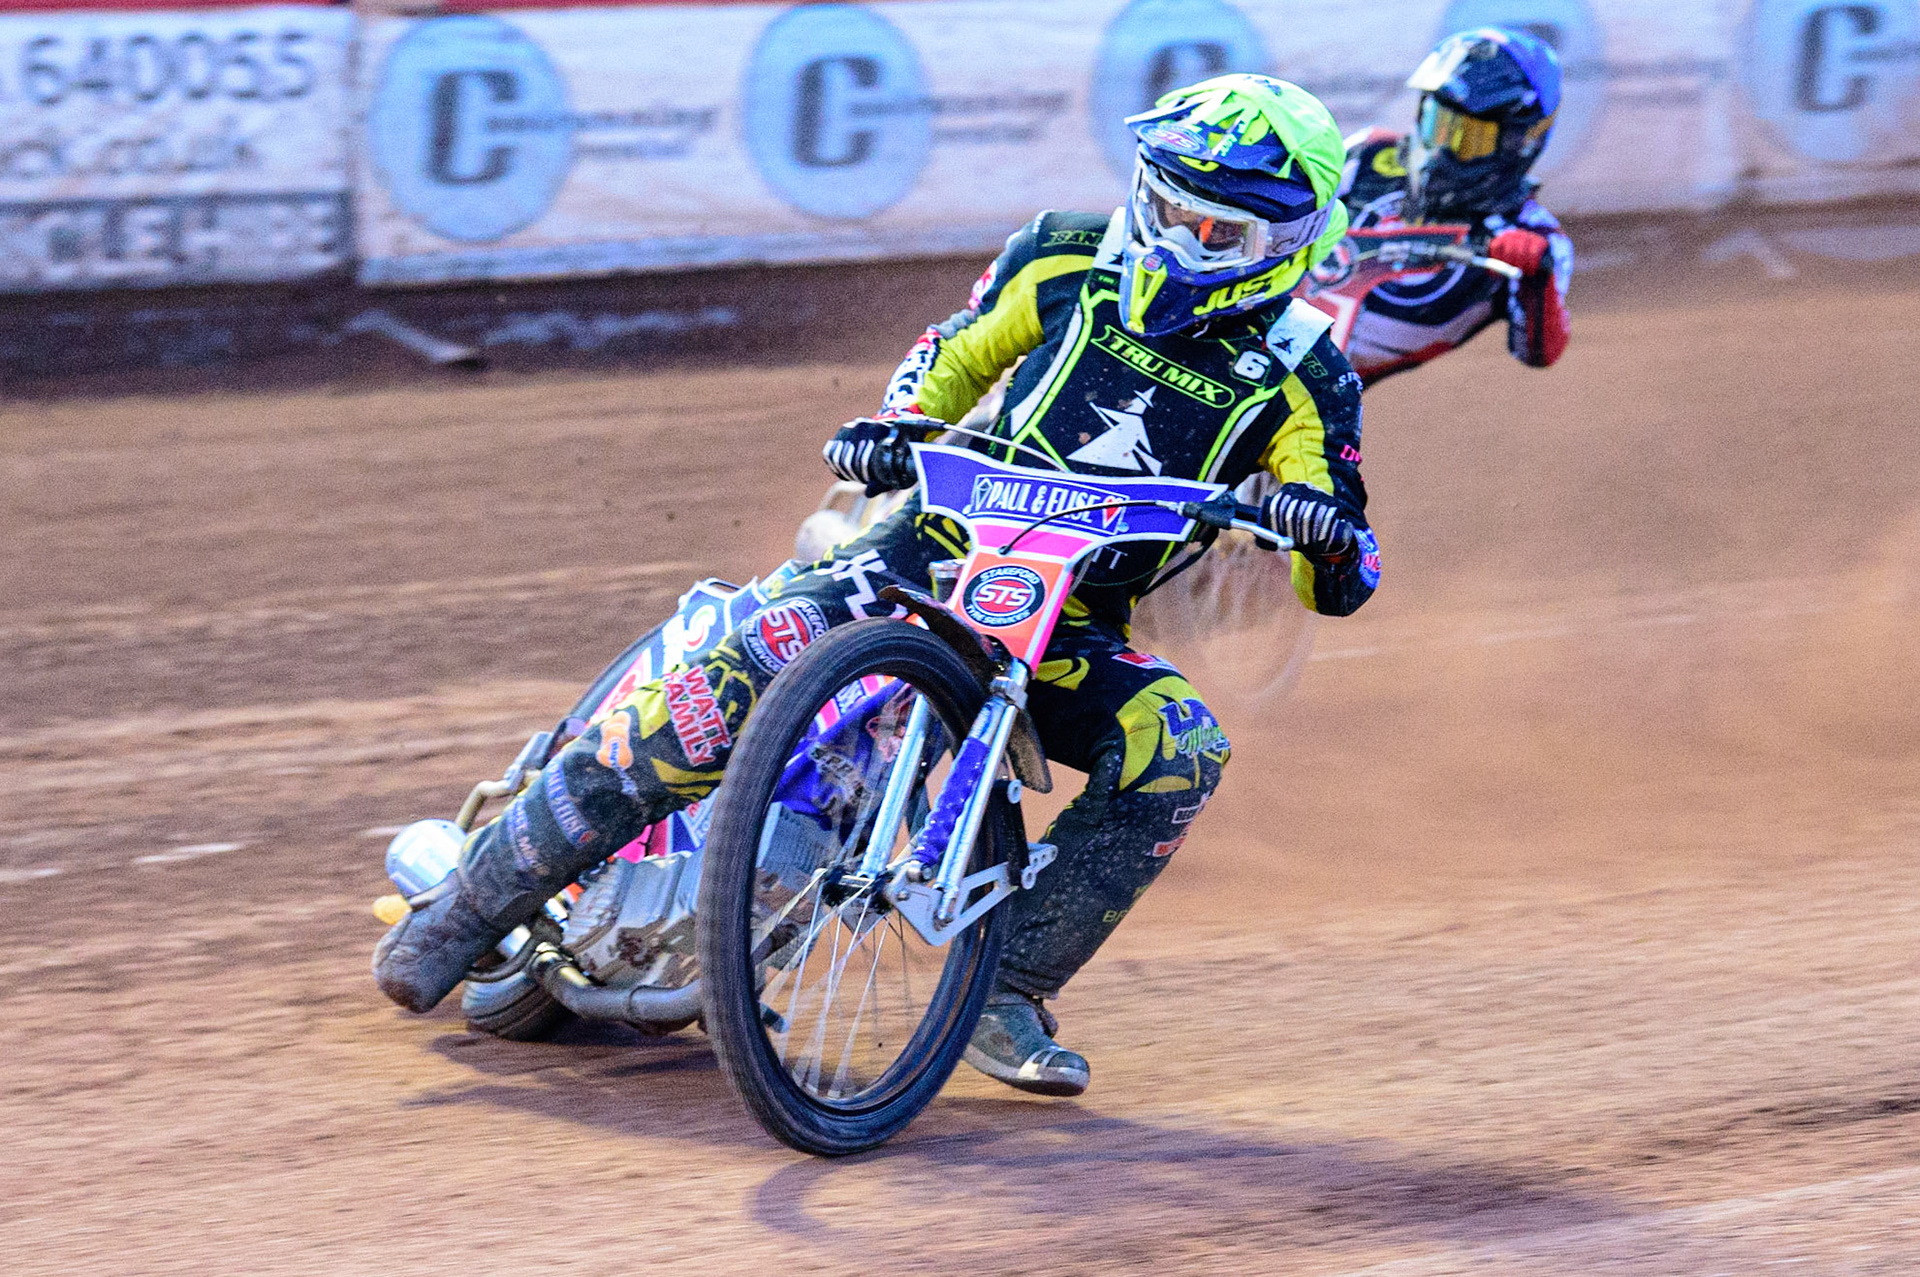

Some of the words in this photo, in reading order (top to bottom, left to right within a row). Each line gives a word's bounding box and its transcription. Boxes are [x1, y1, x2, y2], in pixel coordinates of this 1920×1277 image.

[1109, 335, 1163, 373] TRU
[1161, 367, 1224, 402] MIX
[1233, 350, 1271, 380] 6
[986, 481, 1032, 514] PAUL
[1031, 485, 1047, 514] &
[979, 567, 1041, 585] STAKEFORD
[975, 583, 1032, 607] STS
[982, 610, 1031, 626] SERVICES
[763, 607, 806, 661] STS
[684, 664, 733, 748] WATT
